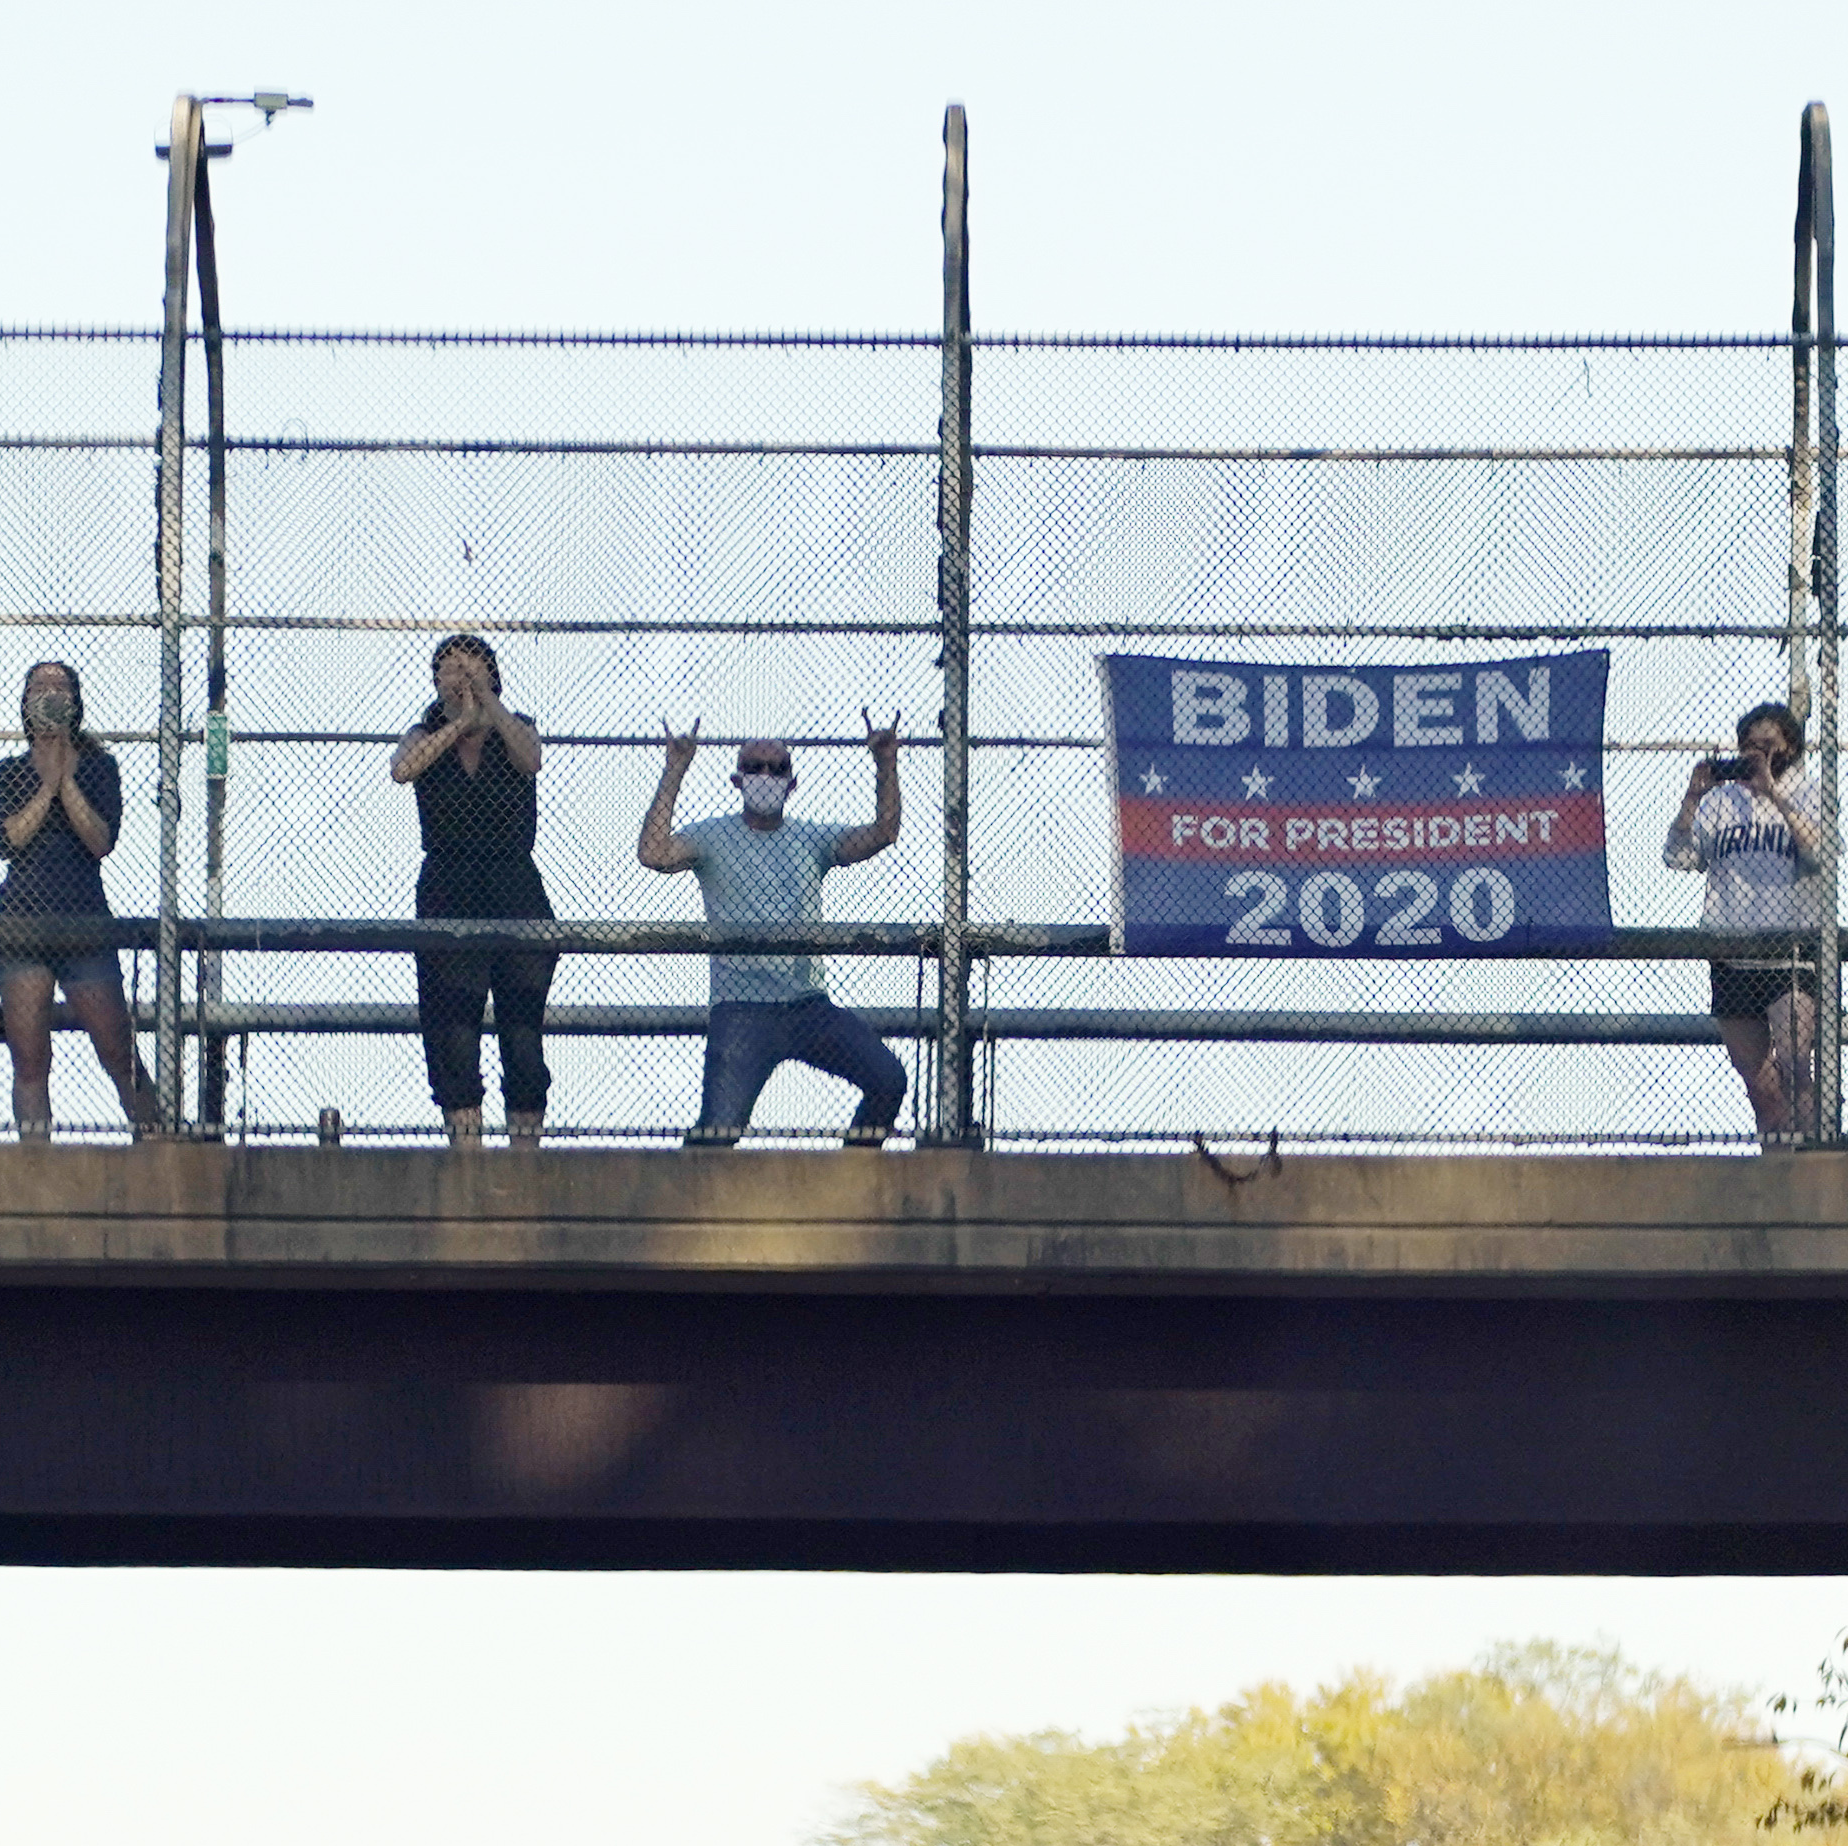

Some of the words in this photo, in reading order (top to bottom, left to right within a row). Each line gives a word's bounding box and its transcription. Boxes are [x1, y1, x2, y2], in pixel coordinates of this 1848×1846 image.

[1171, 667, 1551, 748] BIDEN
[1172, 813, 1271, 850] FOR
[1285, 809, 1559, 851] PRESIDENT
[1224, 867, 1516, 947] 2020
